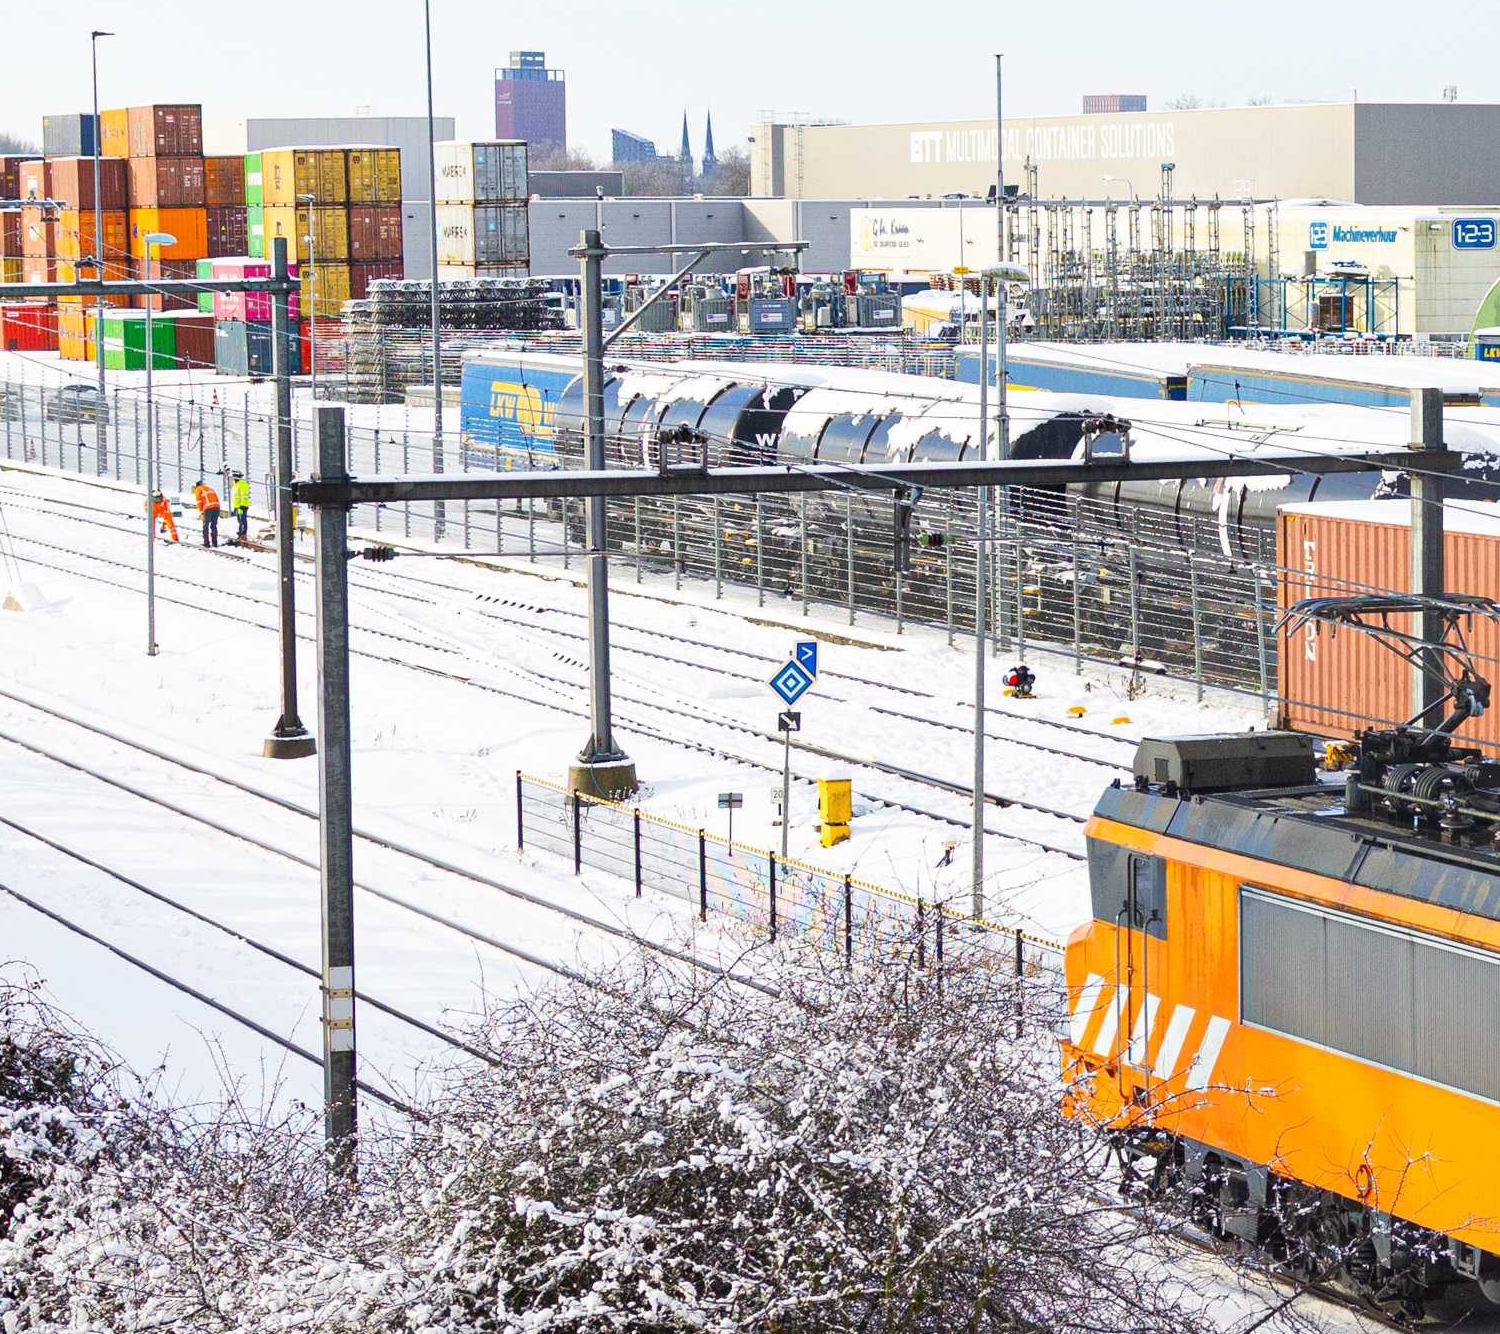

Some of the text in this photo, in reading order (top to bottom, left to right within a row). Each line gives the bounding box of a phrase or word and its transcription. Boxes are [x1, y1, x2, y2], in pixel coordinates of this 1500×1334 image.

[910, 122, 1175, 163] BTT MULTIMODAL CONTAINER SOLUTIONS
[1333, 225, 1397, 243] Machineverhuur
[490, 393, 517, 417] LKW
[1303, 540, 1316, 661] TRION
